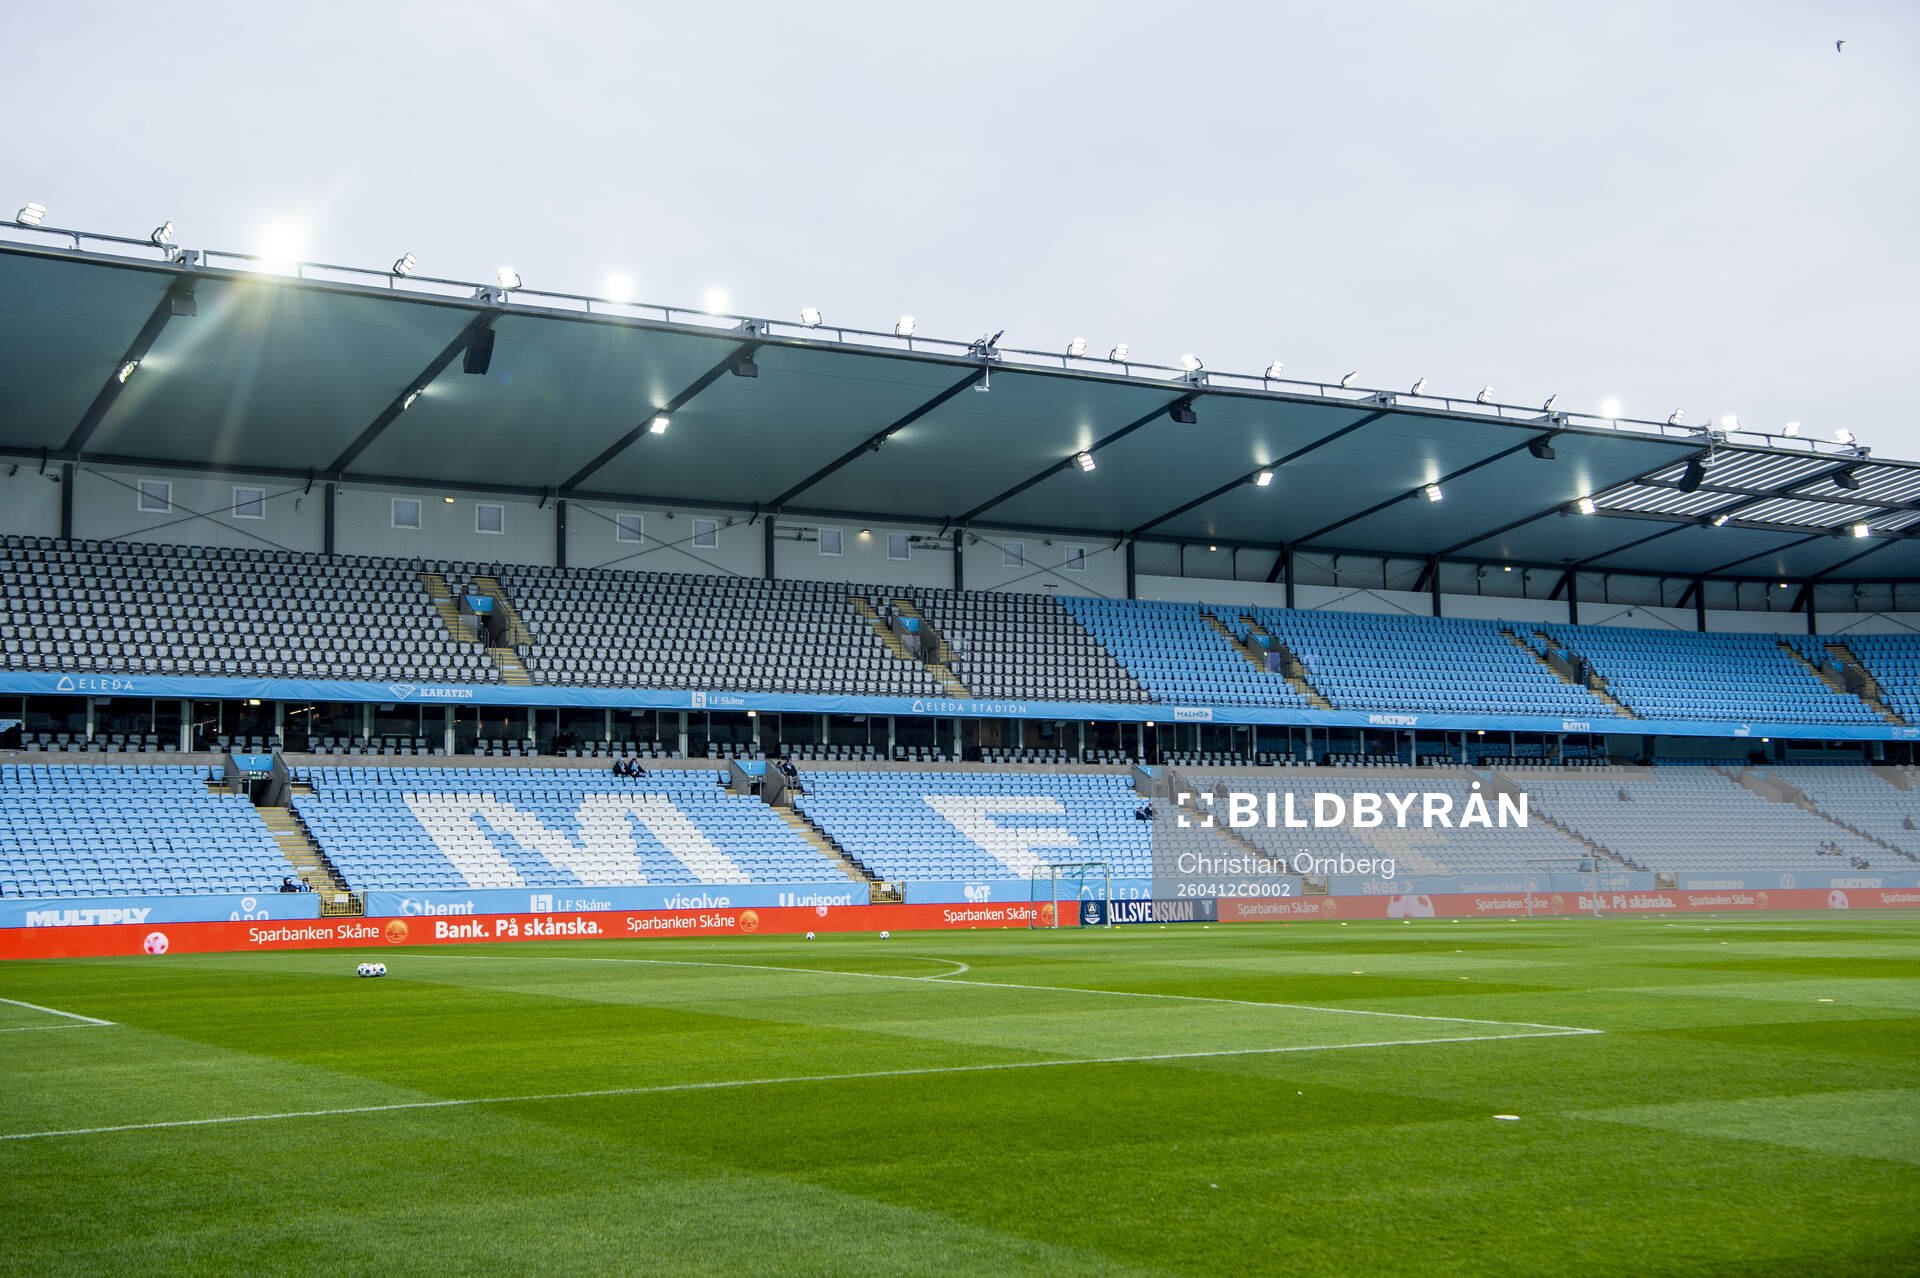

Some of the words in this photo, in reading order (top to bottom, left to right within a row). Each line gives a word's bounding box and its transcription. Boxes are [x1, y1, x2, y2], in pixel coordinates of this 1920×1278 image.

[79, 678, 134, 690] ELEDA
[420, 688, 473, 698] KARATEN
[926, 702, 964, 712] ELEDA
[971, 704, 1026, 714] STADION
[1369, 714, 1418, 726] MULTIPLY
[797, 893, 851, 907] unisport
[1098, 887, 1152, 900] ELEDA
[557, 900, 571, 911] LF
[575, 898, 611, 911] Skåne
[664, 893, 731, 909] visolve
[1475, 898, 1523, 911] Sparbanken
[1613, 896, 1626, 908] På
[1629, 895, 1676, 908] skånska.
[943, 907, 1004, 923] Sparbanken
[1007, 906, 1037, 920] Skåne
[1108, 900, 1194, 923] ALLSVENSKAN
[1237, 902, 1290, 917] Sparbanken
[1292, 901, 1319, 914] Skåne
[26, 907, 151, 927] MULTIPLY
[626, 914, 696, 932] Sparbanken
[700, 913, 735, 928] Skåne
[249, 926, 333, 944] Sparbanken
[337, 924, 380, 939] Skåne
[435, 920, 490, 939] Bank.
[496, 919, 518, 937] På
[524, 917, 603, 935] skånska.
